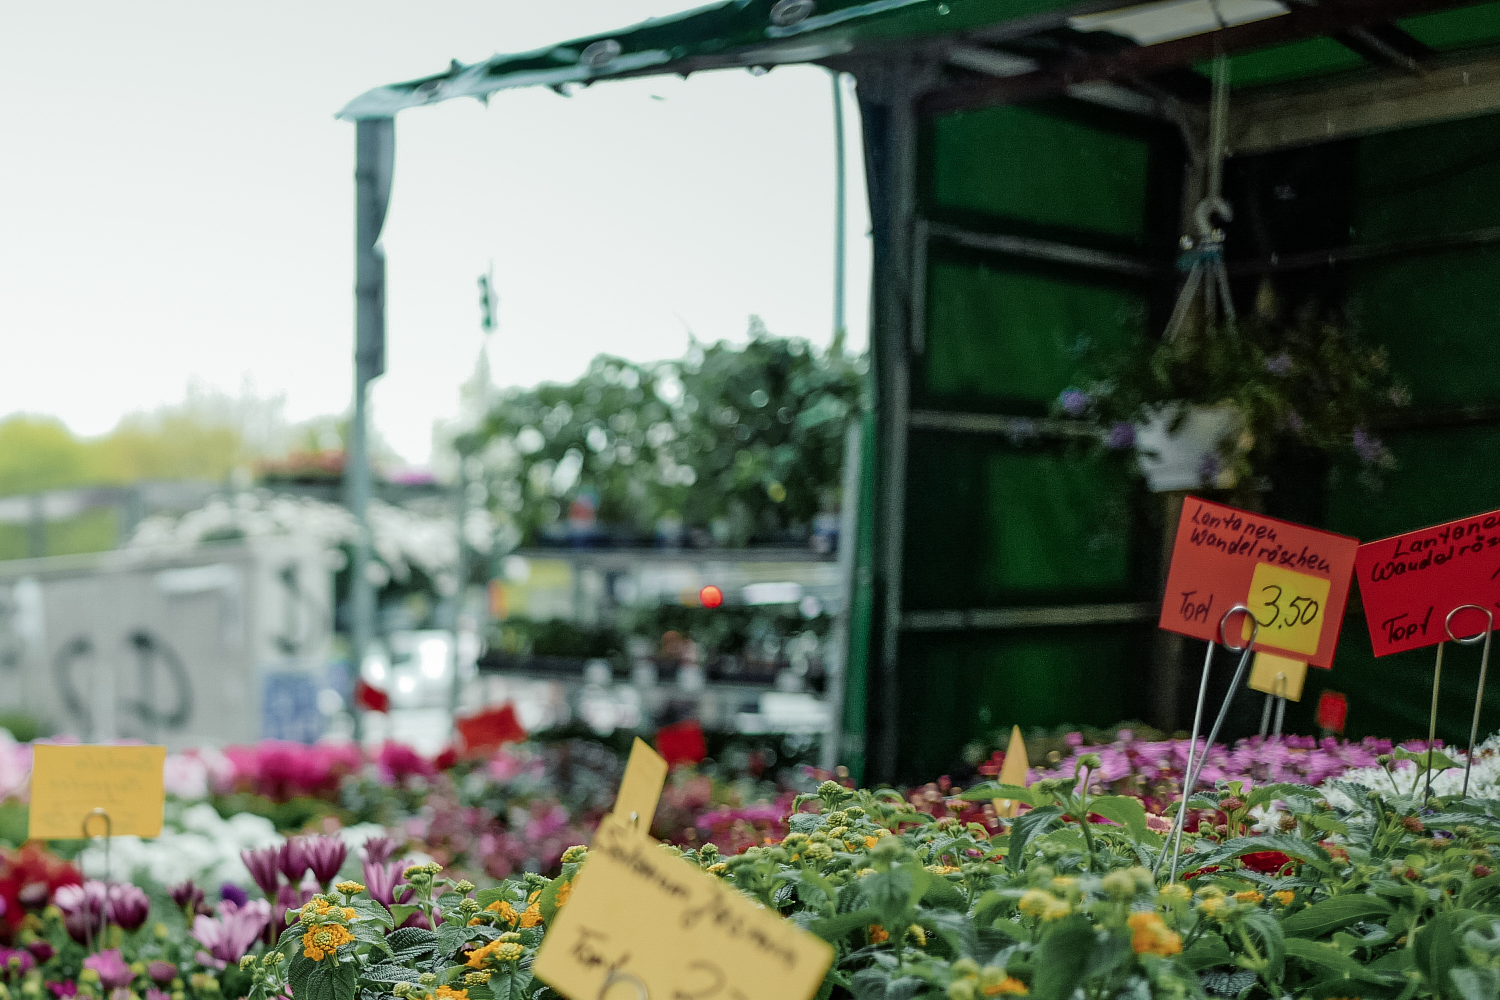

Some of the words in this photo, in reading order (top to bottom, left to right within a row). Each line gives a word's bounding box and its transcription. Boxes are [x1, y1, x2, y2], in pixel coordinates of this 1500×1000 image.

[1393, 516, 1500, 559] Lantane
[1257, 584, 1319, 629] 3.50
[1382, 605, 1434, 644] Topf
